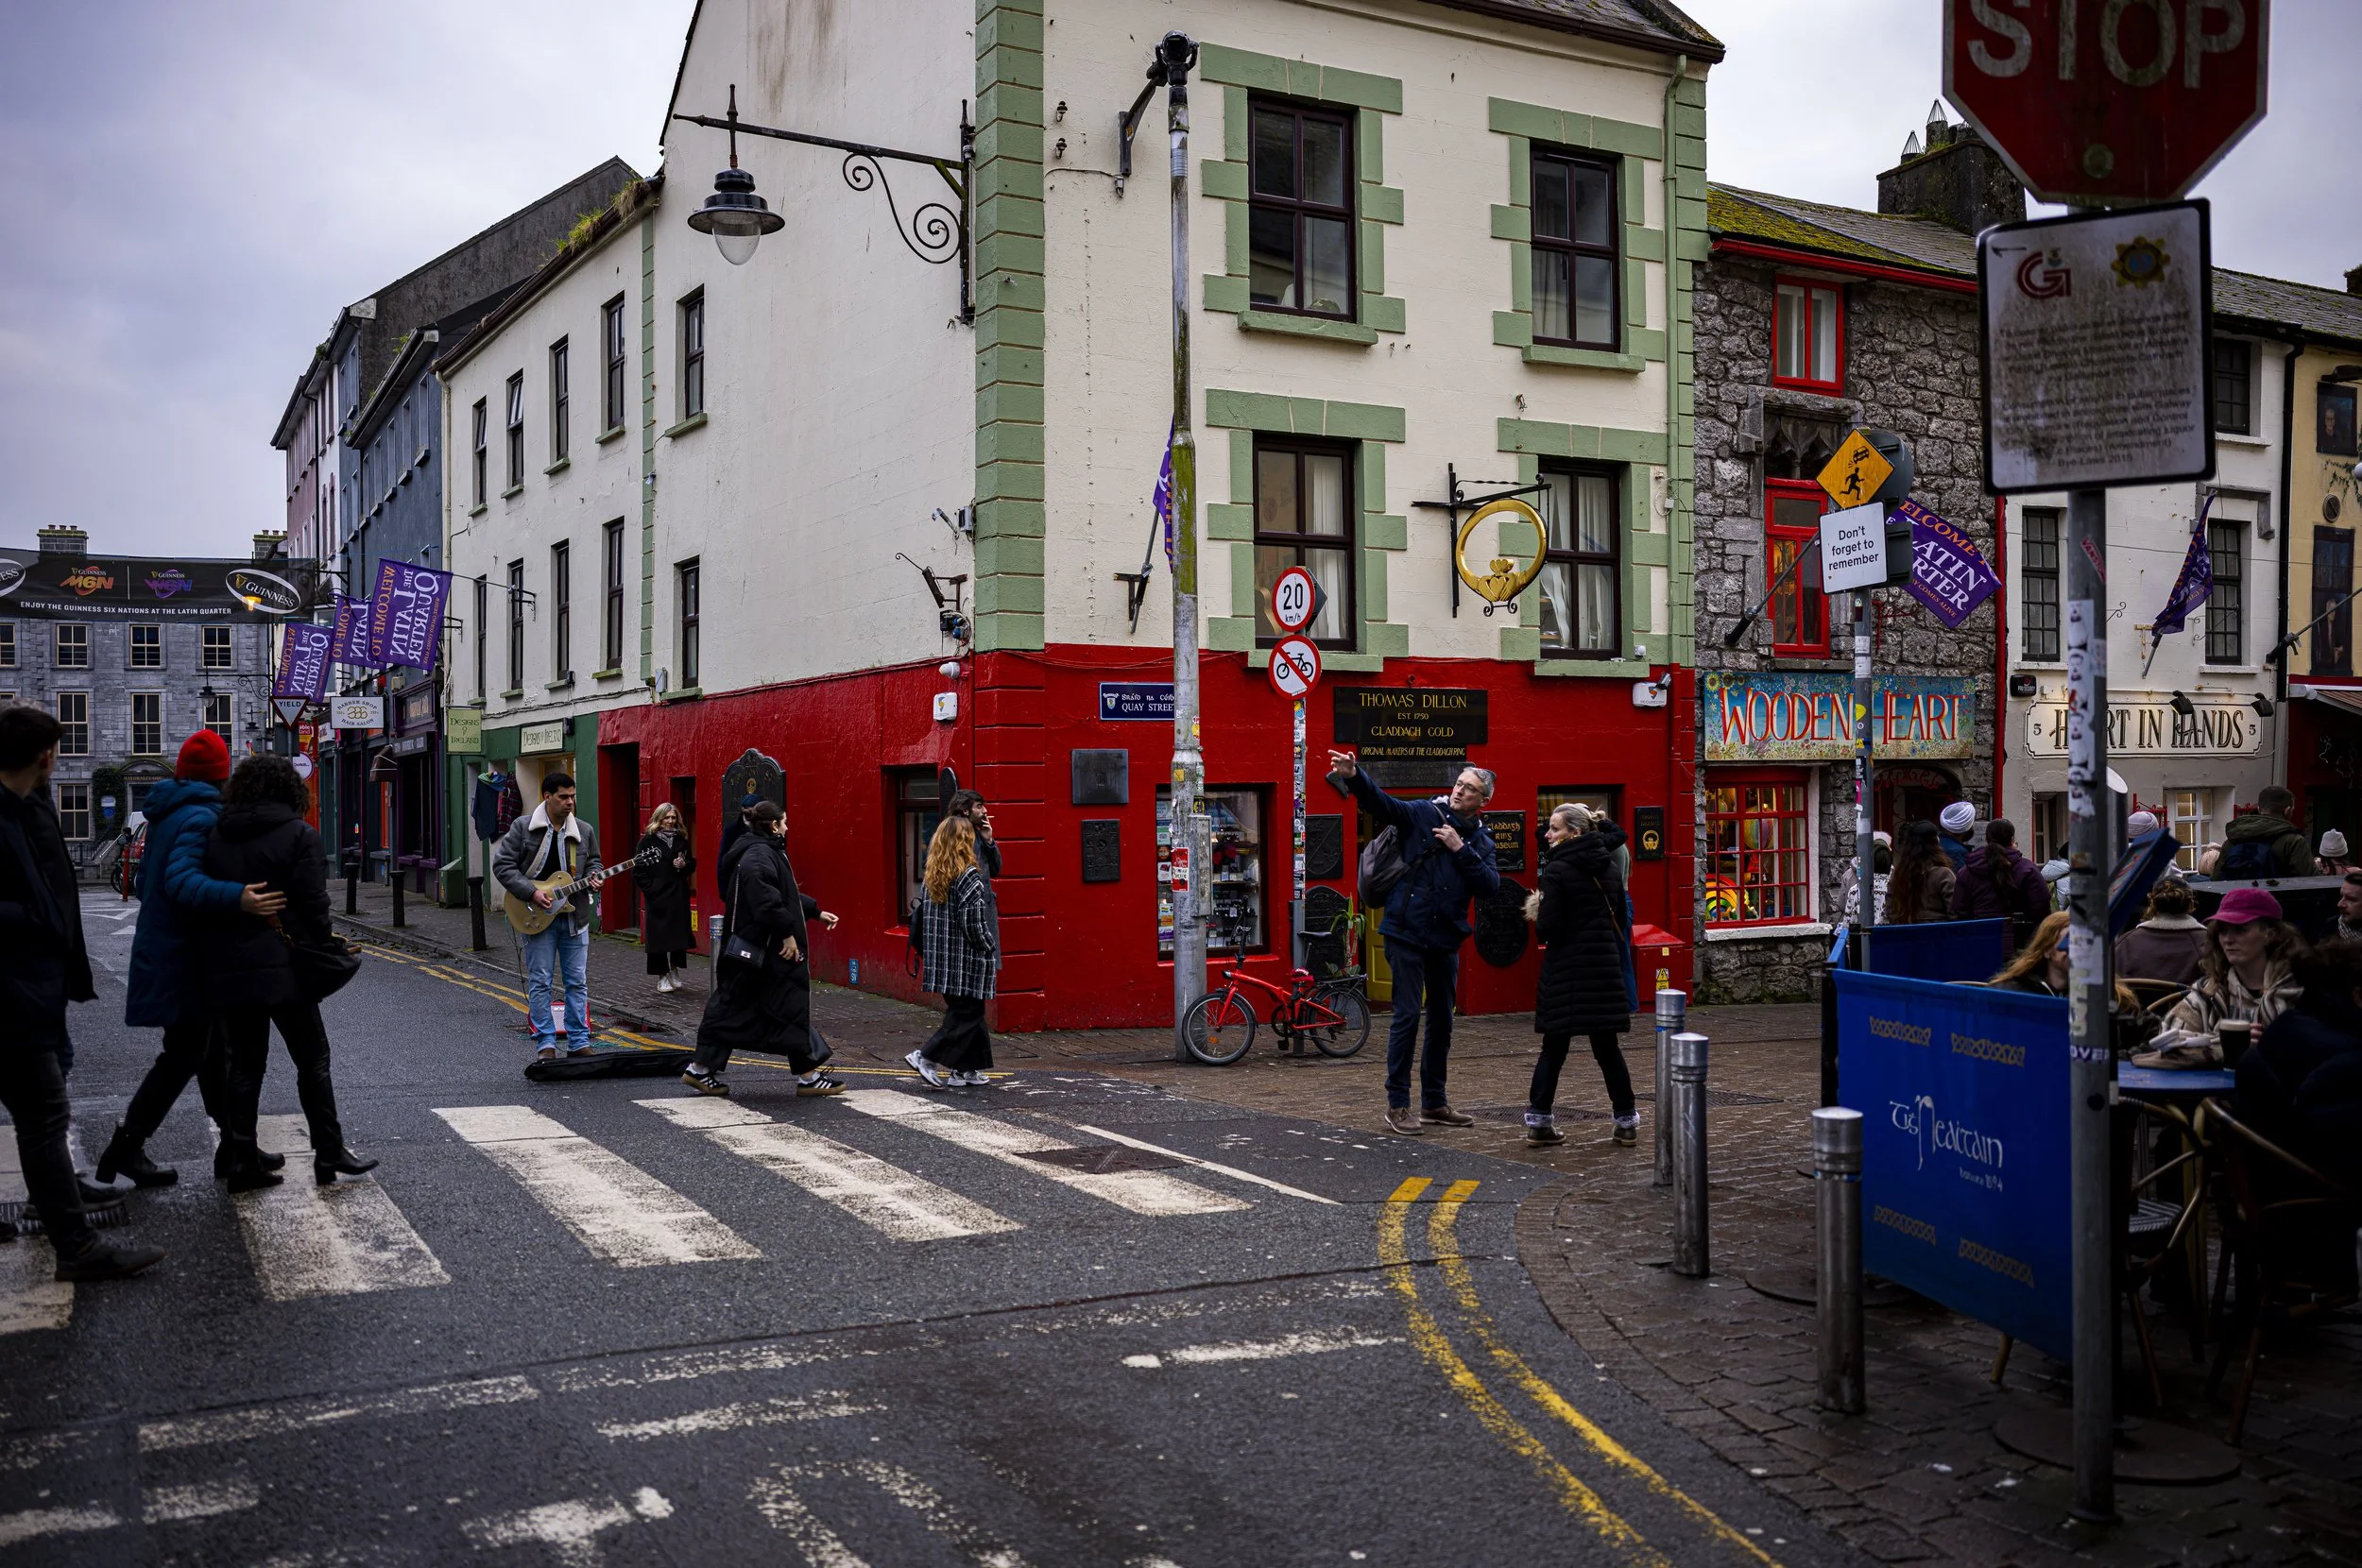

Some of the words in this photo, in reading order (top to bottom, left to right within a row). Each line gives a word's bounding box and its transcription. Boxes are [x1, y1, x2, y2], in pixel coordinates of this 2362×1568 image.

[1839, 525, 1866, 540] Don't
[1831, 540, 1861, 556] forget
[1863, 539, 1874, 550] to
[1828, 553, 1879, 571] remember
[1911, 538, 1988, 591] ATIN
[157, 571, 187, 579] GUINNESS
[246, 581, 296, 607] GUINNESS
[1283, 583, 1304, 610] 20
[20, 601, 45, 609] ENJOY
[47, 602, 62, 610] THE
[63, 604, 102, 613] GUINNESS
[104, 605, 116, 614] SIX
[117, 606, 150, 615] NATIONS
[1284, 612, 1302, 623] km/h
[336, 700, 360, 710] BARBER
[361, 700, 378, 709] SHOP
[1121, 702, 1144, 712] QUAY
[1359, 692, 1414, 707] THOMAS
[1422, 694, 1467, 708] DILLON
[341, 718, 355, 726] HAIR
[355, 718, 375, 726] SALON
[1718, 686, 1855, 746] WOODEN
[1371, 725, 1421, 737] CLADDAGH
[1428, 726, 1454, 737] GOLD
[2033, 723, 2042, 736] 5
[2049, 708, 2131, 750] HRT
[2137, 708, 2165, 748] IN
[2172, 708, 2244, 749] HANDS
[2248, 724, 2256, 736] 5
[1361, 746, 1385, 756] ORIGINAL
[1409, 746, 1415, 756] OF
[1416, 746, 1426, 756] THE
[1426, 746, 1453, 756] CLADDAGH
[1453, 746, 1465, 756] RING
